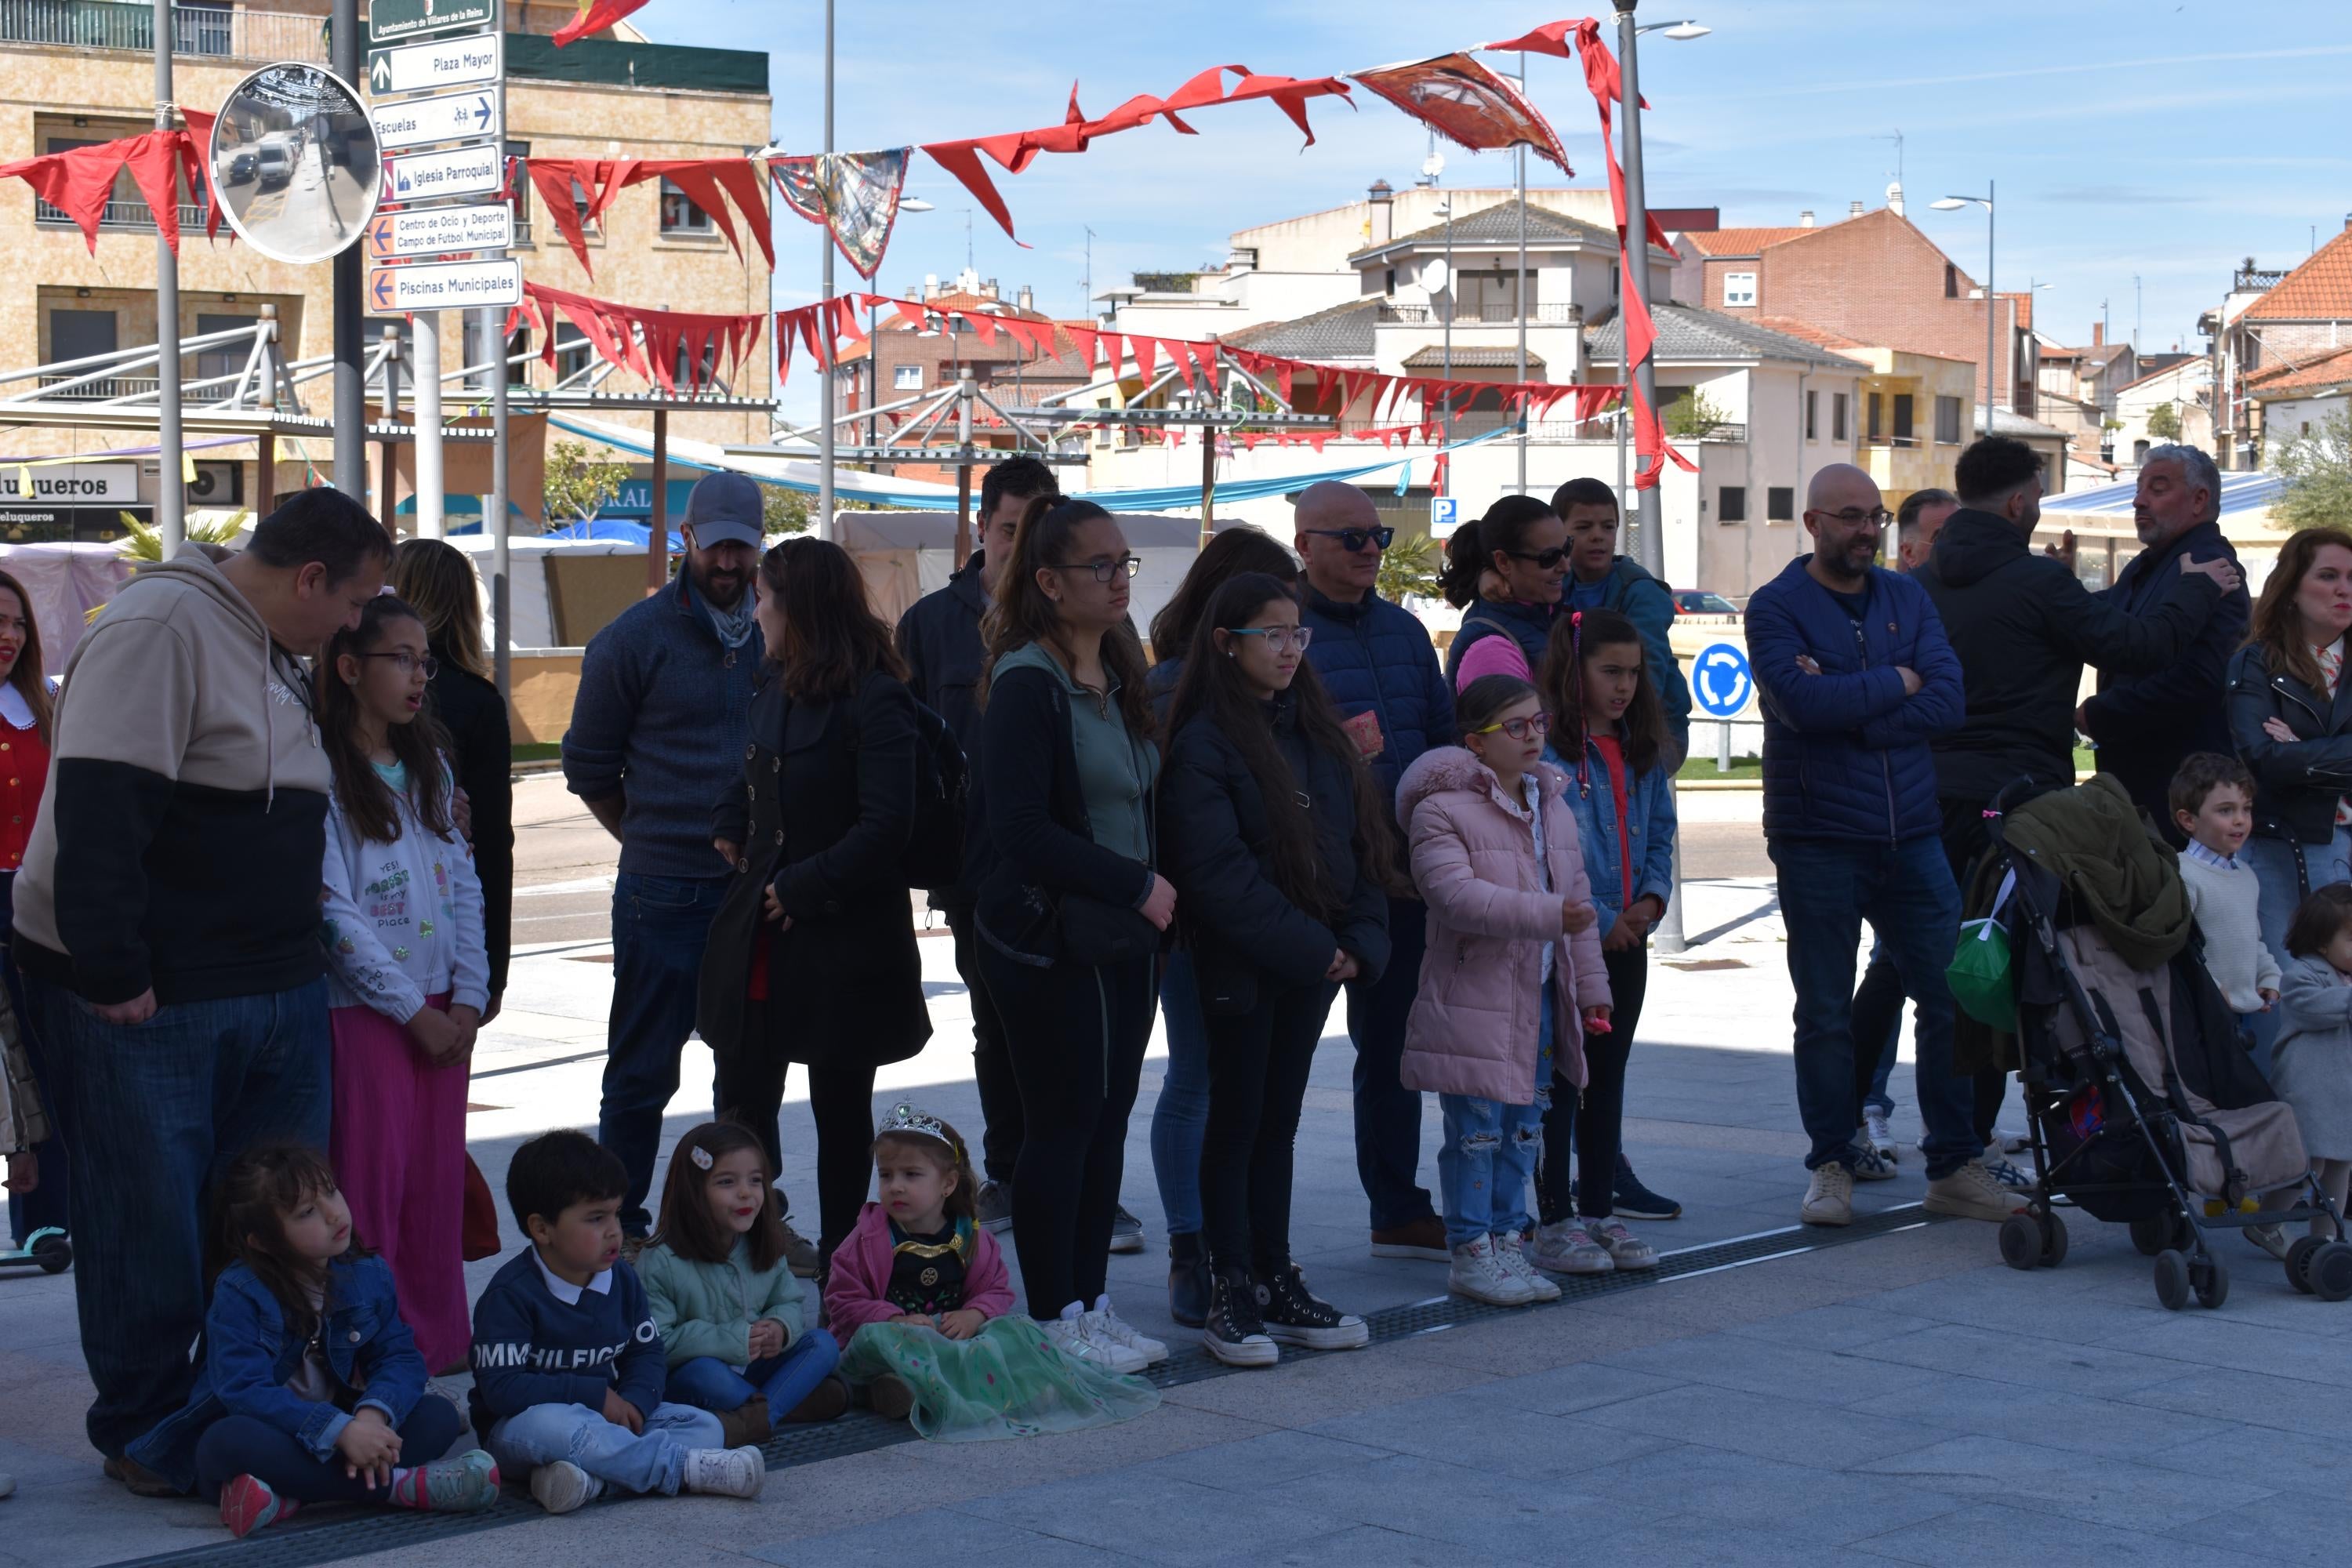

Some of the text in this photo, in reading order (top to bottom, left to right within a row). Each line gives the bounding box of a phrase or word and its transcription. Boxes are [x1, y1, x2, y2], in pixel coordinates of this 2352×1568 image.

[378, 8, 483, 36] Ayuntamiento de Villares de la Reina
[434, 53, 492, 71] Plaza Mayor
[376, 118, 416, 135] Escuelas
[414, 162, 494, 187] Iglesia Parroquial
[400, 211, 505, 230] Centro de Ocio y Deporte
[397, 236, 424, 249] Campo
[426, 235, 436, 245] de
[467, 228, 505, 241] Municipal
[401, 276, 514, 295] Piscinas Municipales
[0, 511, 54, 523] eluqueros
[1435, 500, 1452, 521] P
[379, 860, 400, 873] YES!
[370, 902, 405, 916] BEST
